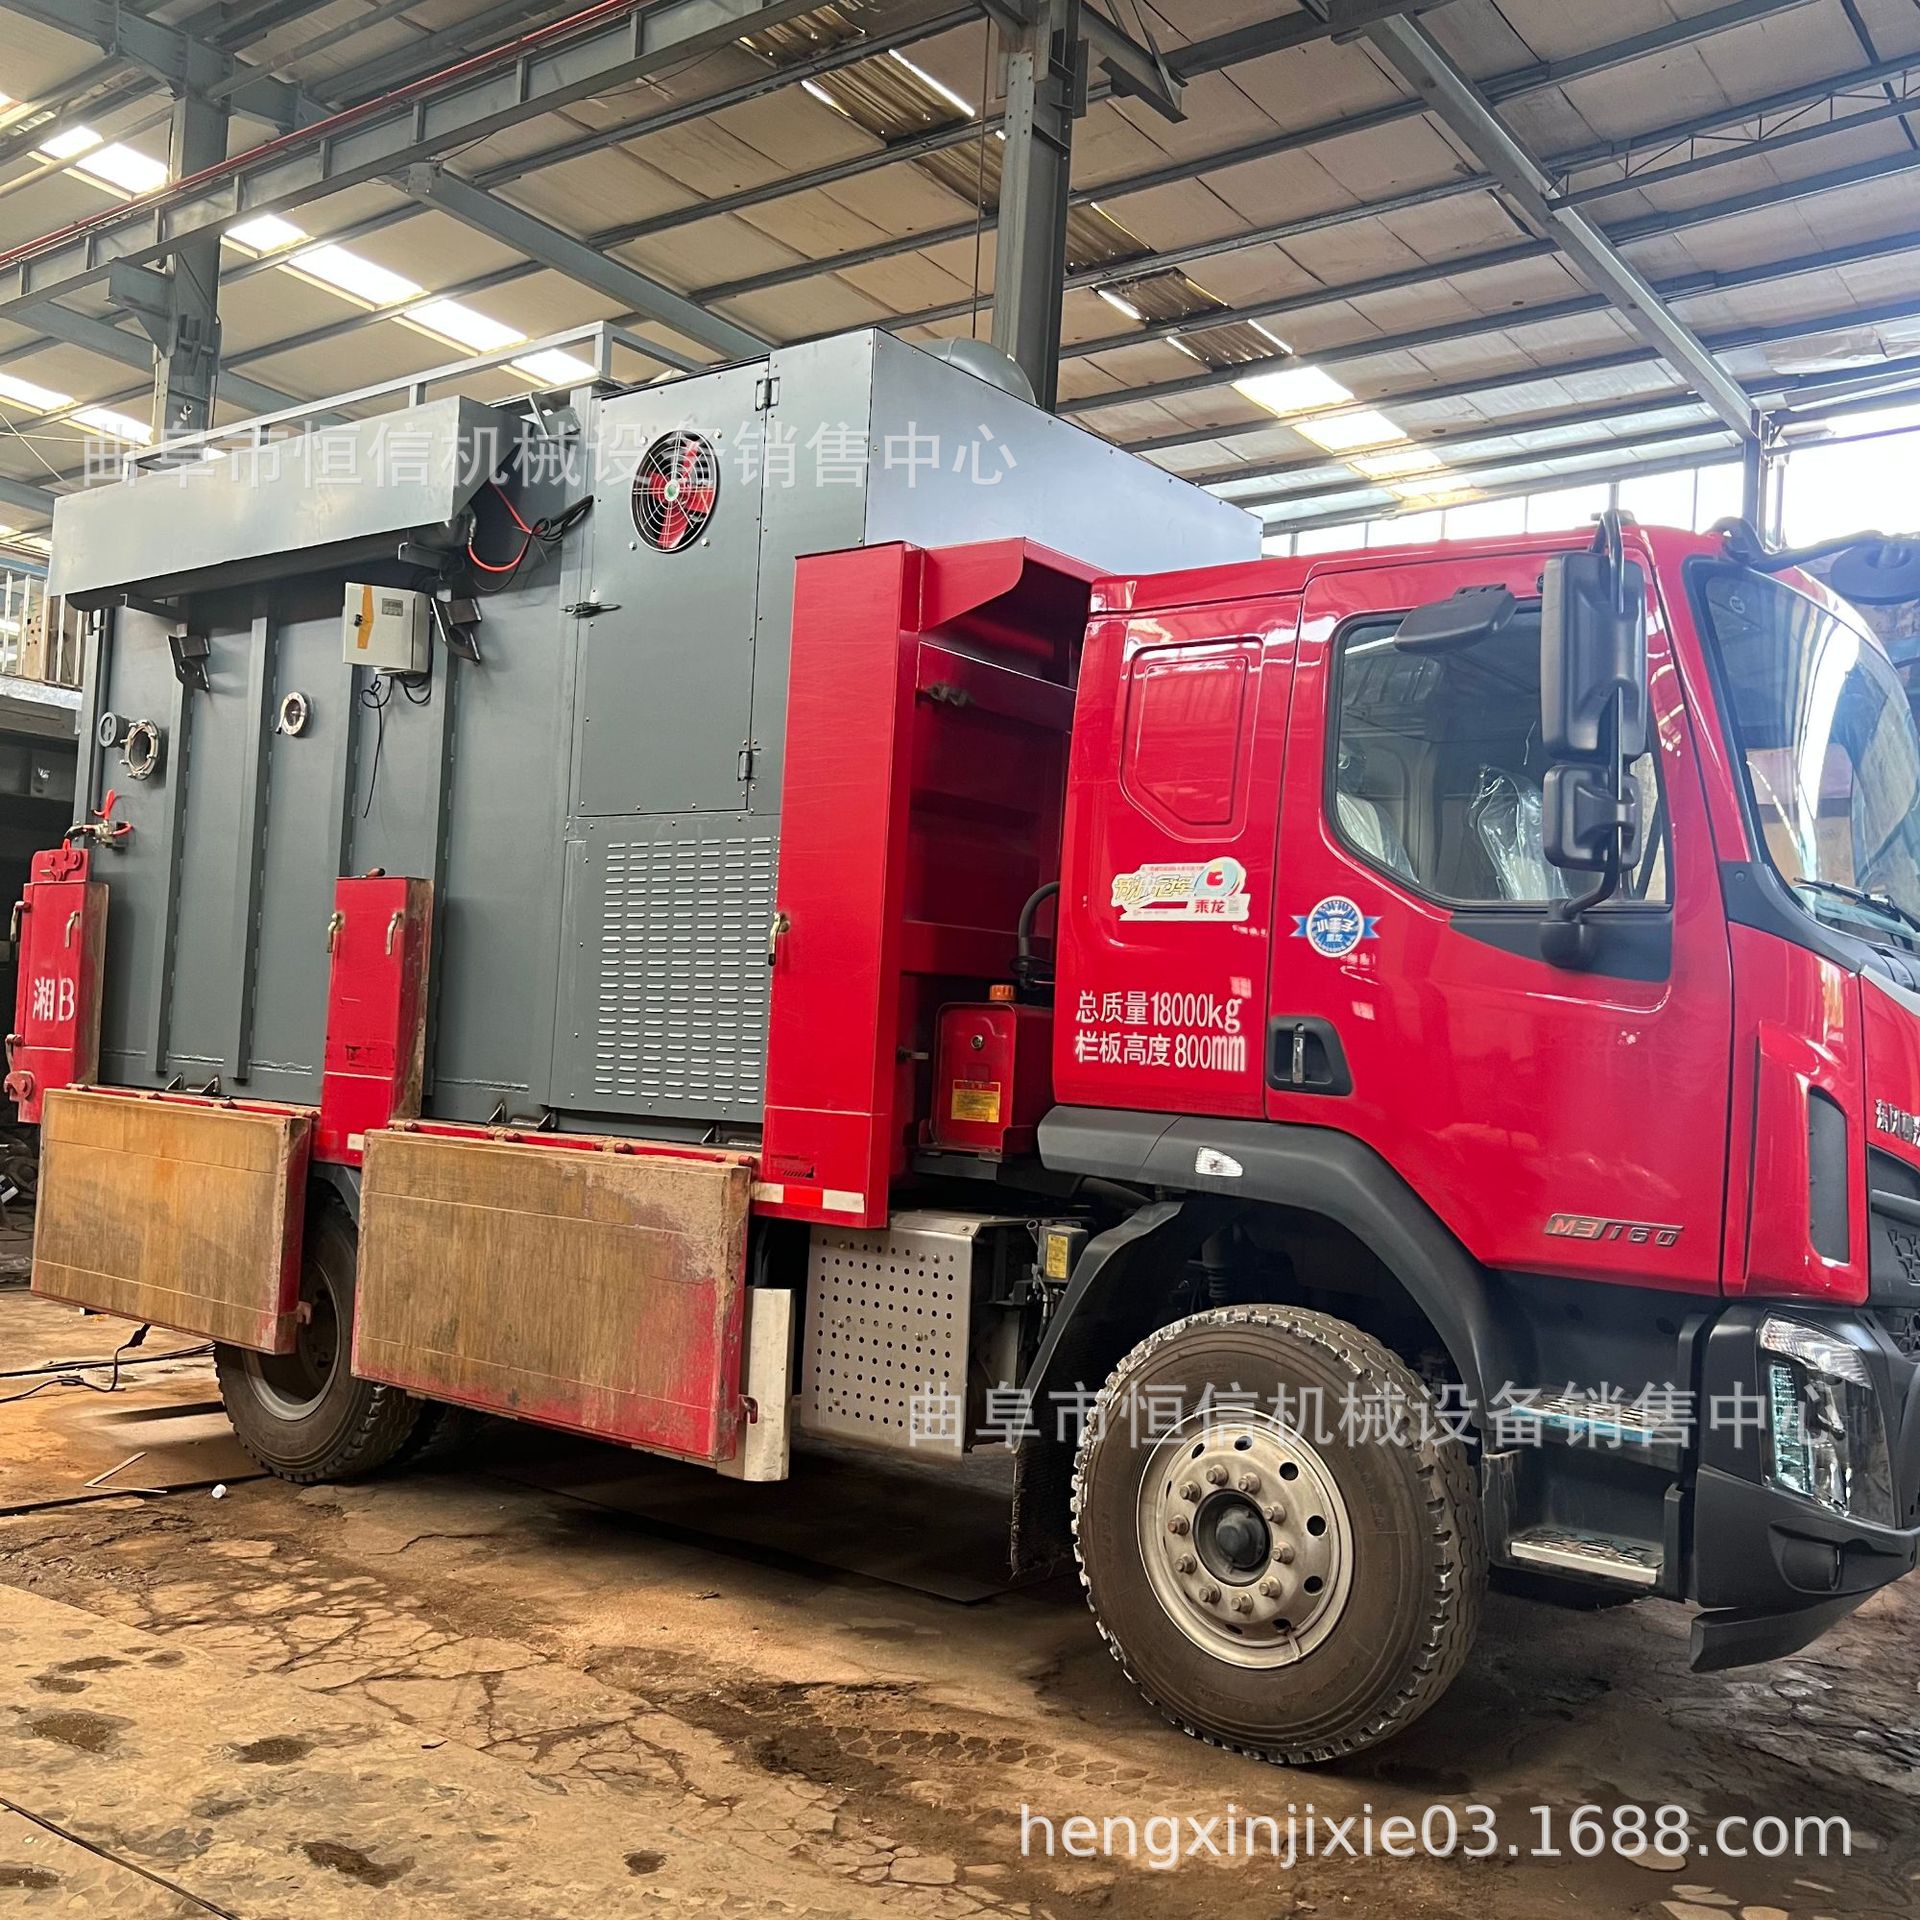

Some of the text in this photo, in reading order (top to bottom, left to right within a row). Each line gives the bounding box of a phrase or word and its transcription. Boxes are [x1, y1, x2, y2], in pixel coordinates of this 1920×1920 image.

[1194, 899, 1226, 914] 乘龙
[32, 976, 75, 1022] 湘B
[1075, 990, 1243, 1034] 总质量18000kg
